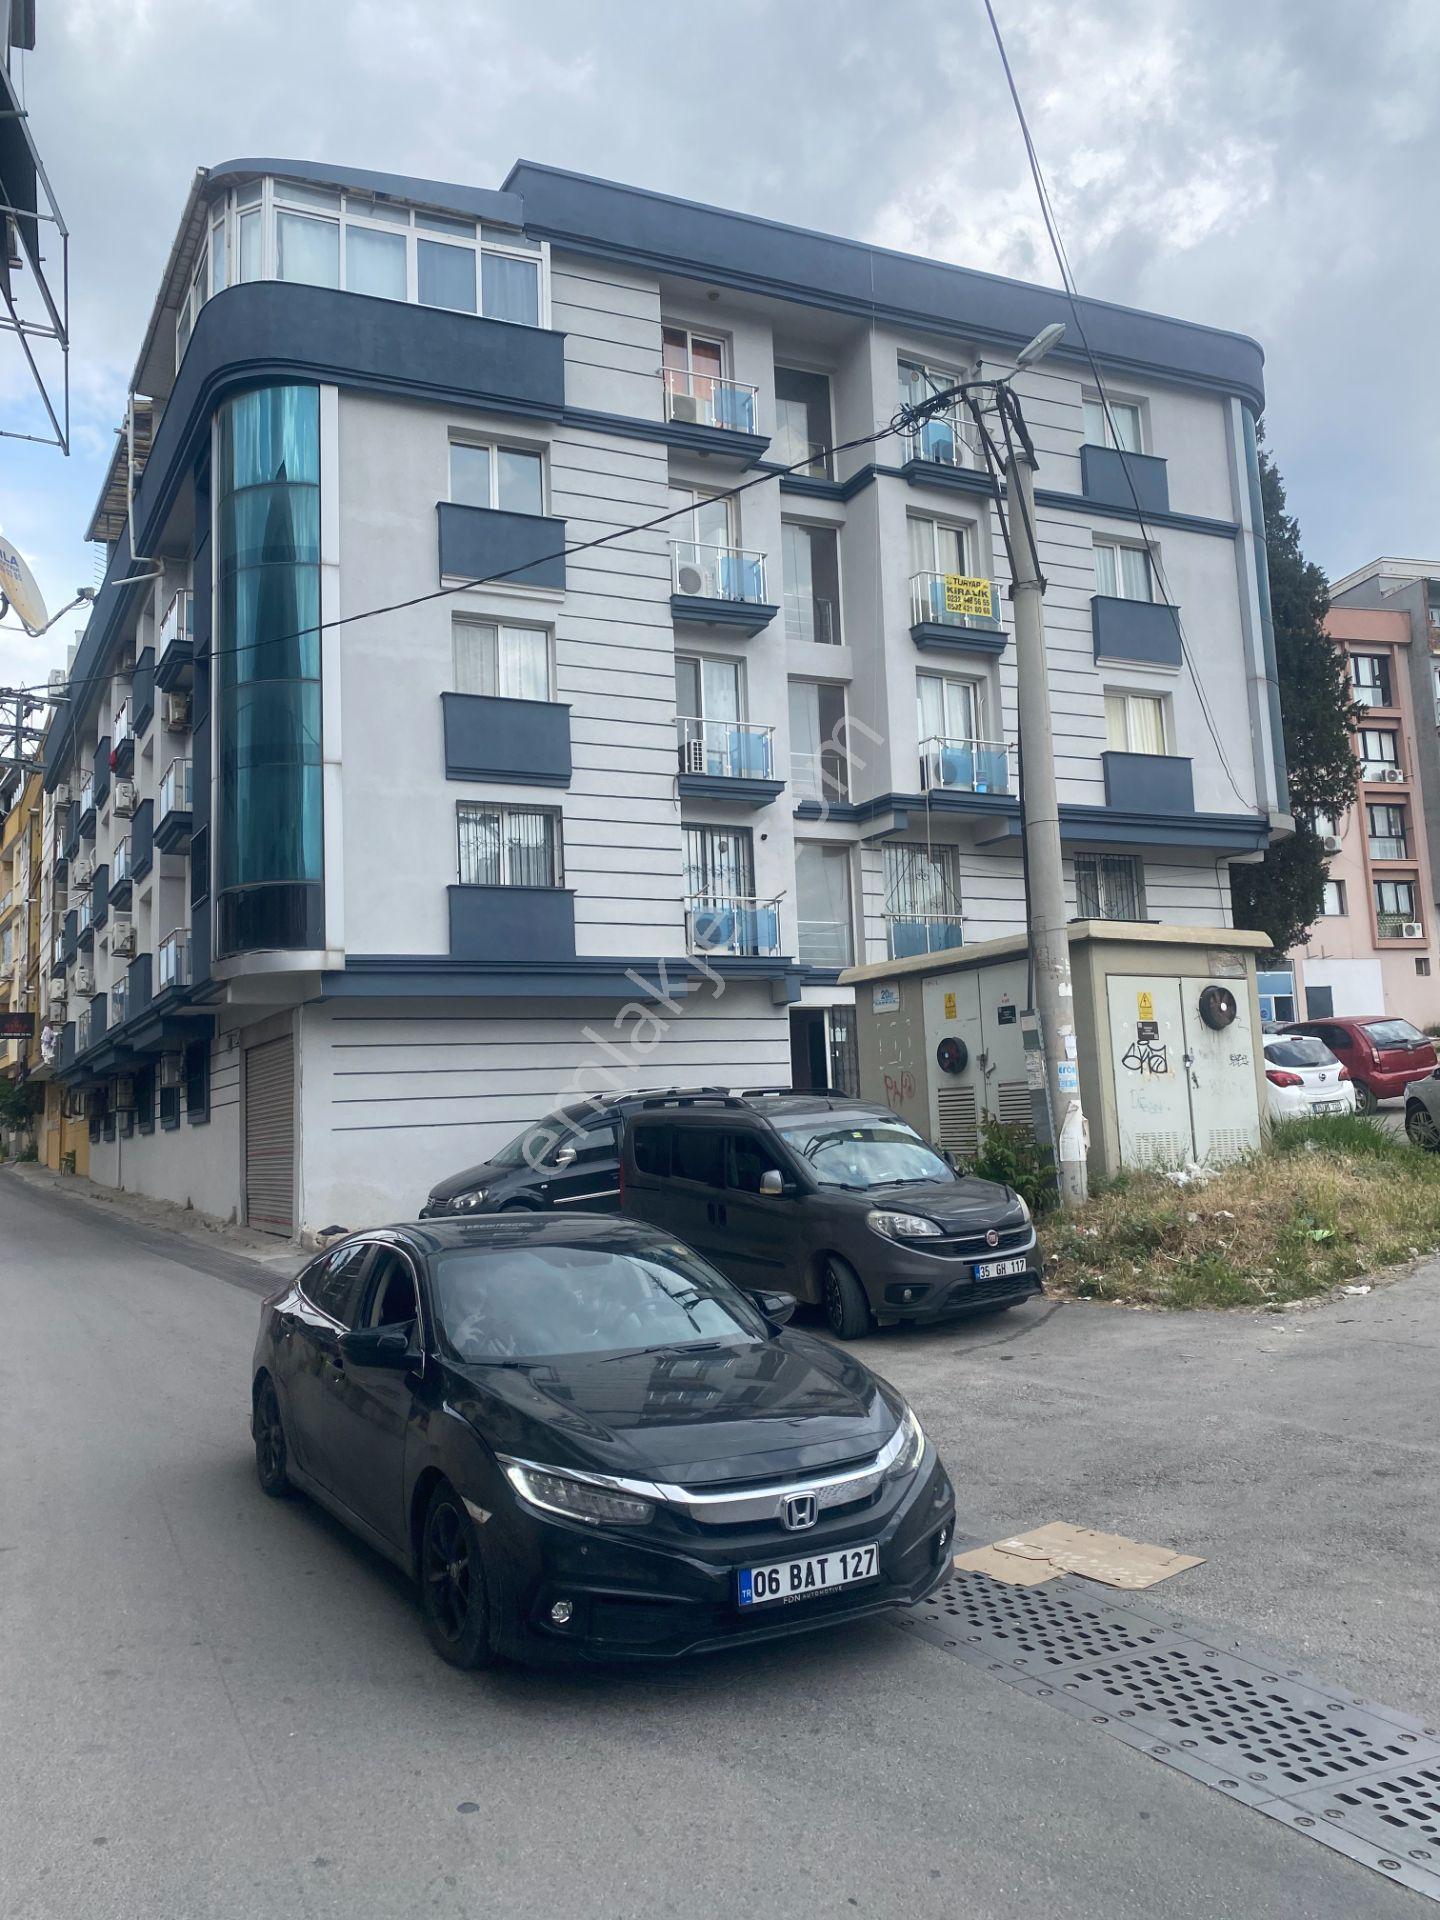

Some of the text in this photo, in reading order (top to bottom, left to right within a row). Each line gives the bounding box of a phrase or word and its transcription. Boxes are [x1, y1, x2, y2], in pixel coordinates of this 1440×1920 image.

[953, 577, 981, 588] TURYAP
[981, 1259, 1025, 1278] 35 GH 117
[753, 1548, 875, 1598] 06 BAT 127
[741, 1589, 752, 1598] TR
[783, 1585, 843, 1605] FDN AUTOMOTIVE
